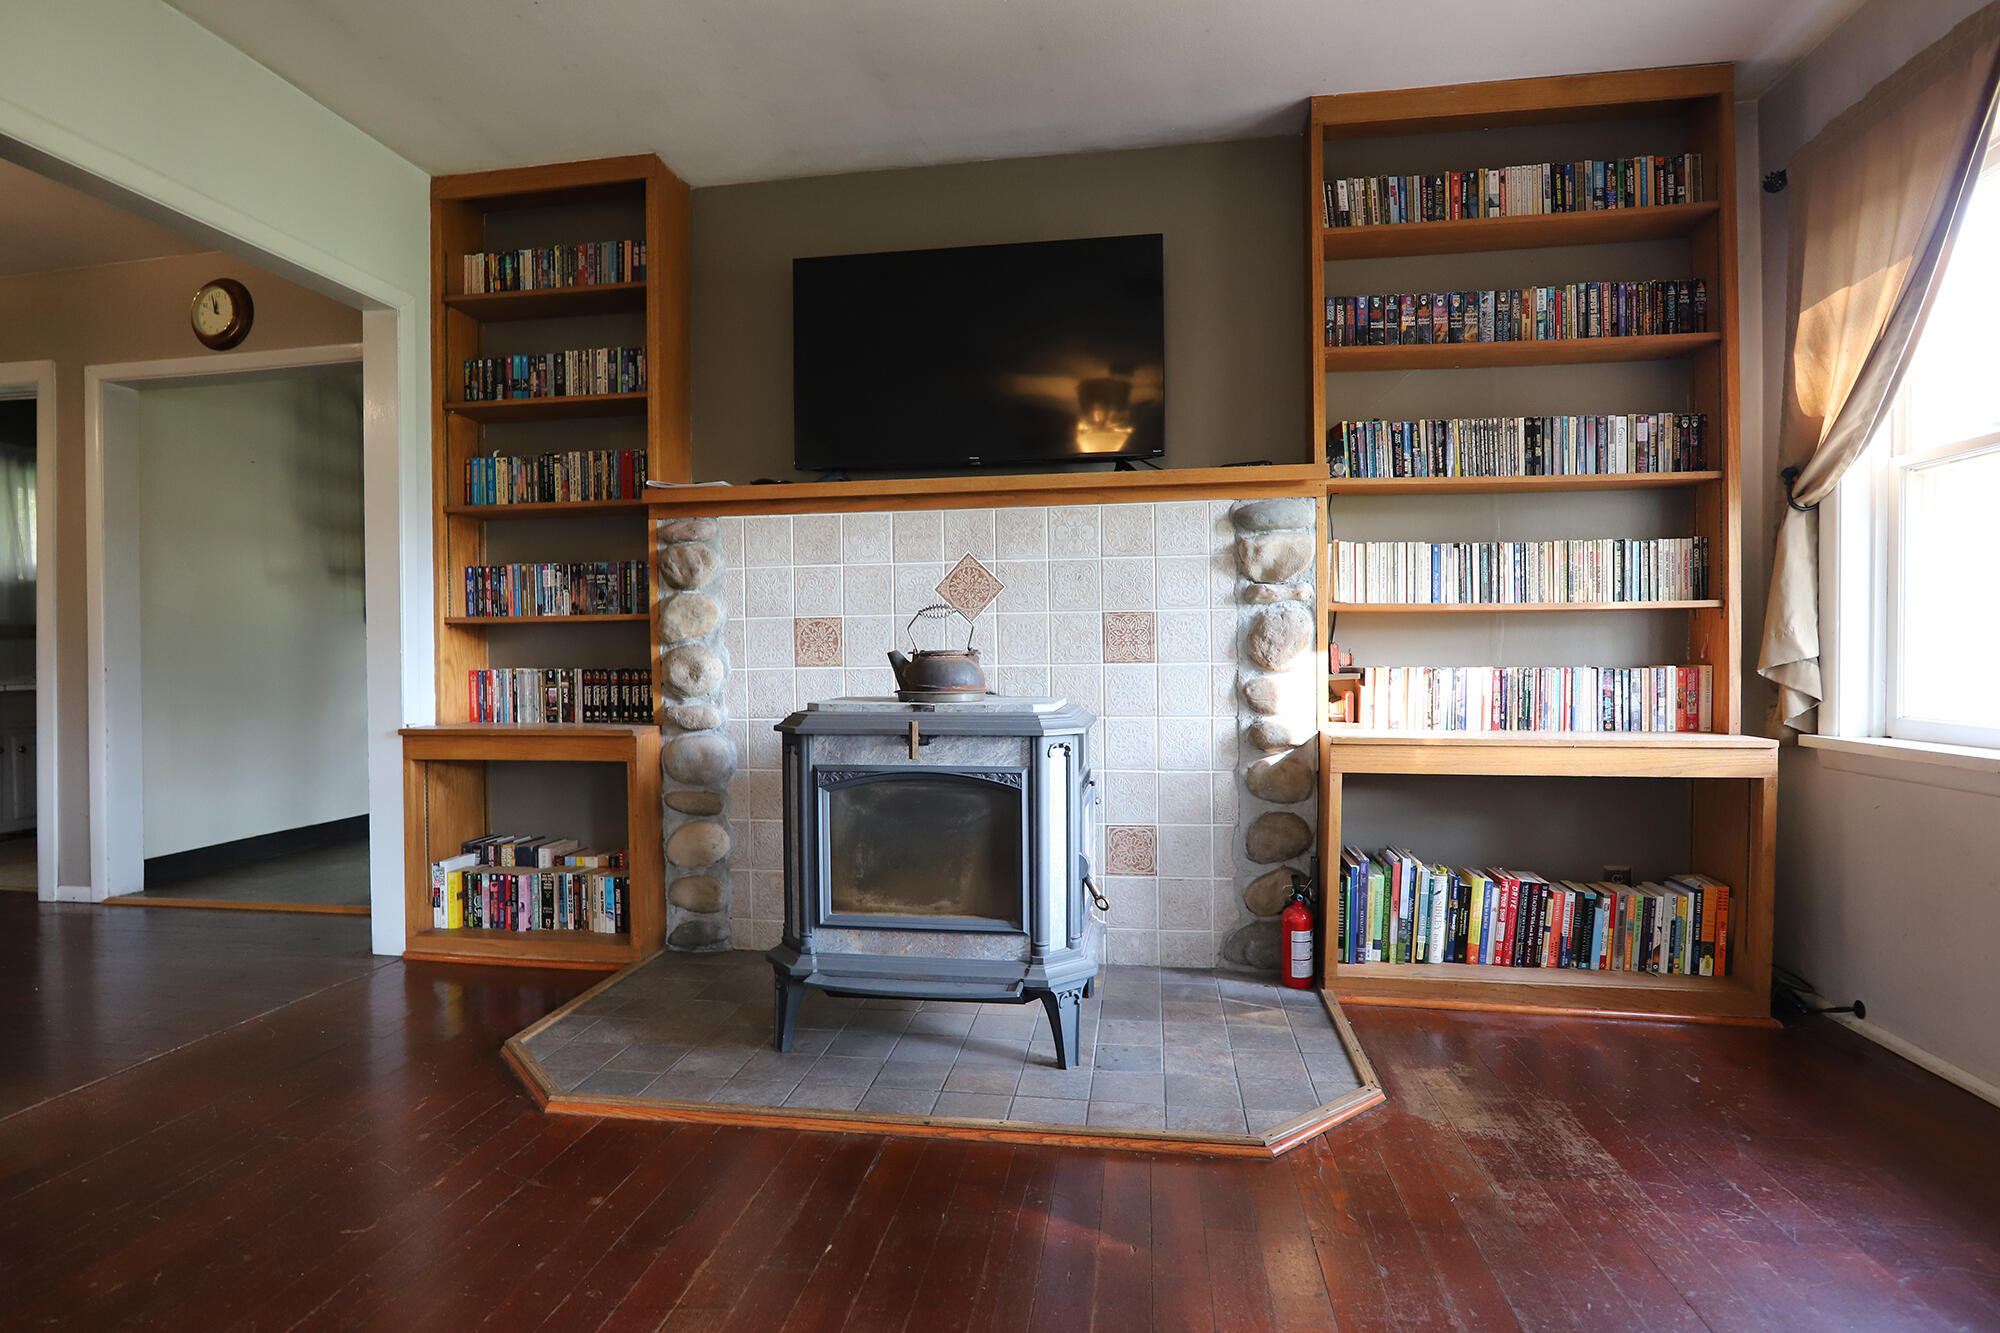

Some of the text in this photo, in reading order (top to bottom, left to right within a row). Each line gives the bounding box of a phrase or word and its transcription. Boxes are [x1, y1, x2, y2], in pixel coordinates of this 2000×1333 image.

[1501, 881, 1509, 891] IT'S
[1510, 886, 1518, 909] DRIVE
[1434, 901, 1443, 931] SIBLEY
